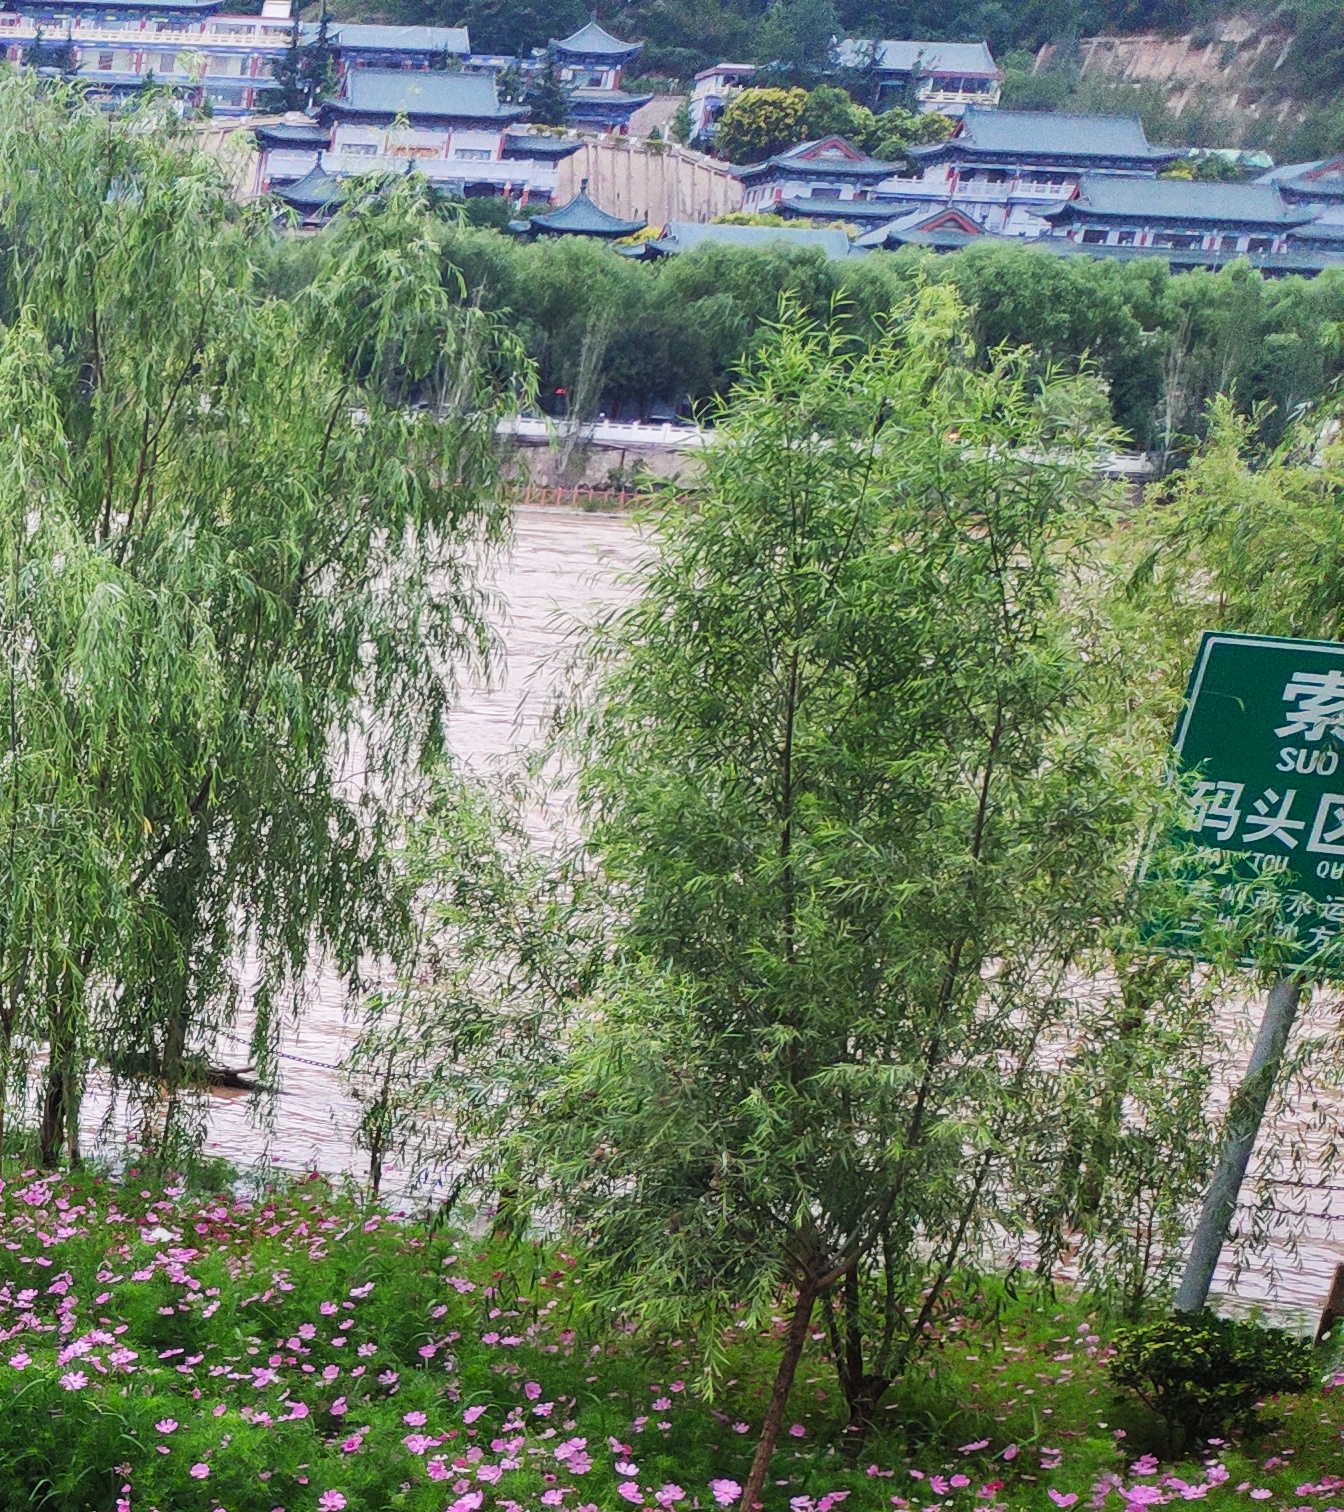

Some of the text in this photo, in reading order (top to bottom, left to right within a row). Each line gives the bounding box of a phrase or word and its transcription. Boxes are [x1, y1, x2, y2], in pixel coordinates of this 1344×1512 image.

[1274, 670, 1344, 741] 索
[1275, 747, 1339, 775] SUO
[1186, 781, 1344, 855] 码头区
